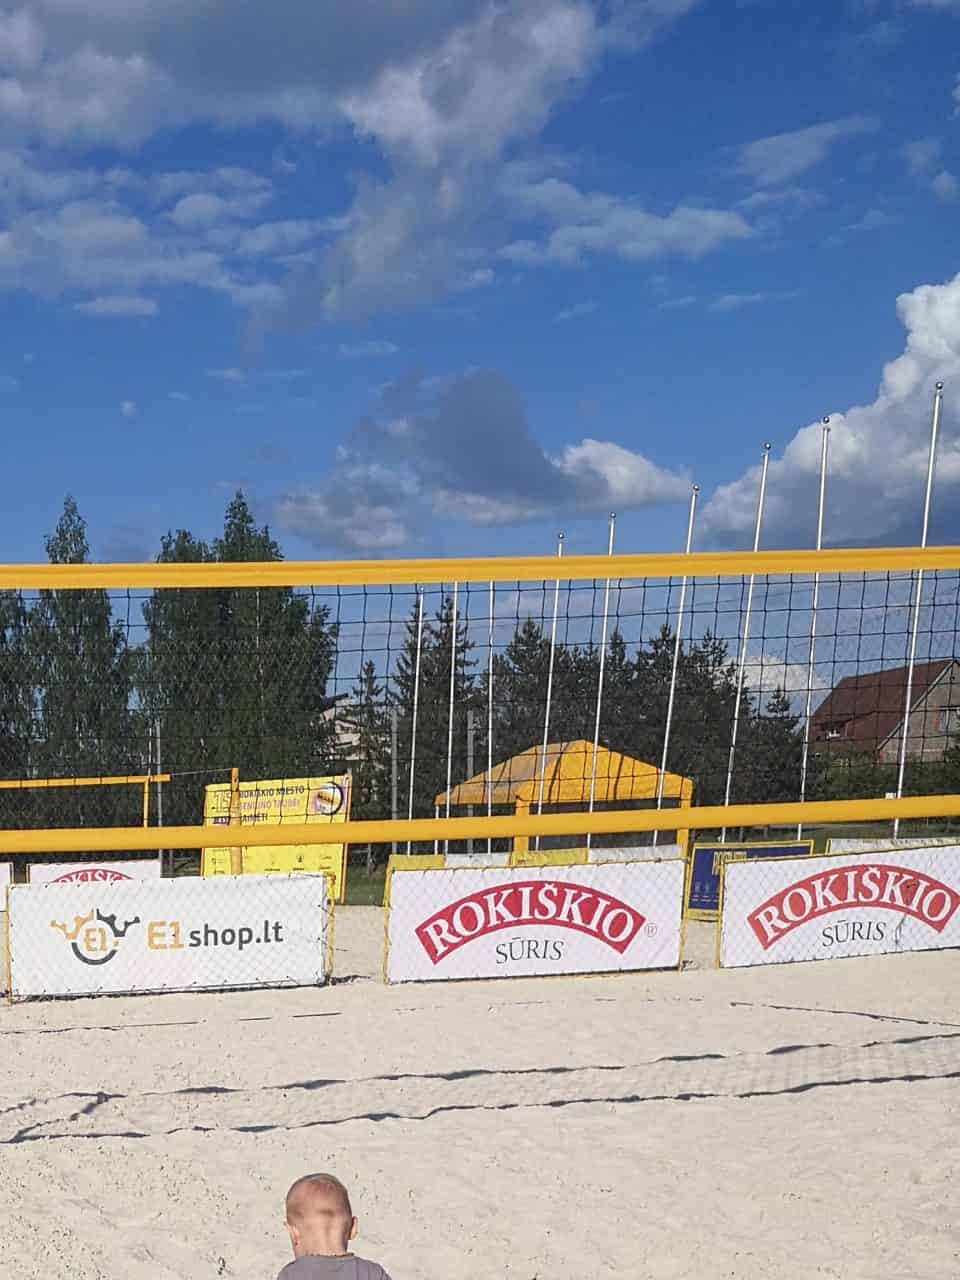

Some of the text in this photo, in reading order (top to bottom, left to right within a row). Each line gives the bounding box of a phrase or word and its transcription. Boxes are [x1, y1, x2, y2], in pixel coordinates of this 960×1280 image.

[423, 882, 635, 956] ROKIŠKIO
[754, 866, 952, 945] ROKIŠKIO
[495, 936, 565, 965] SŪRIS
[822, 919, 887, 947] SŪRIS
